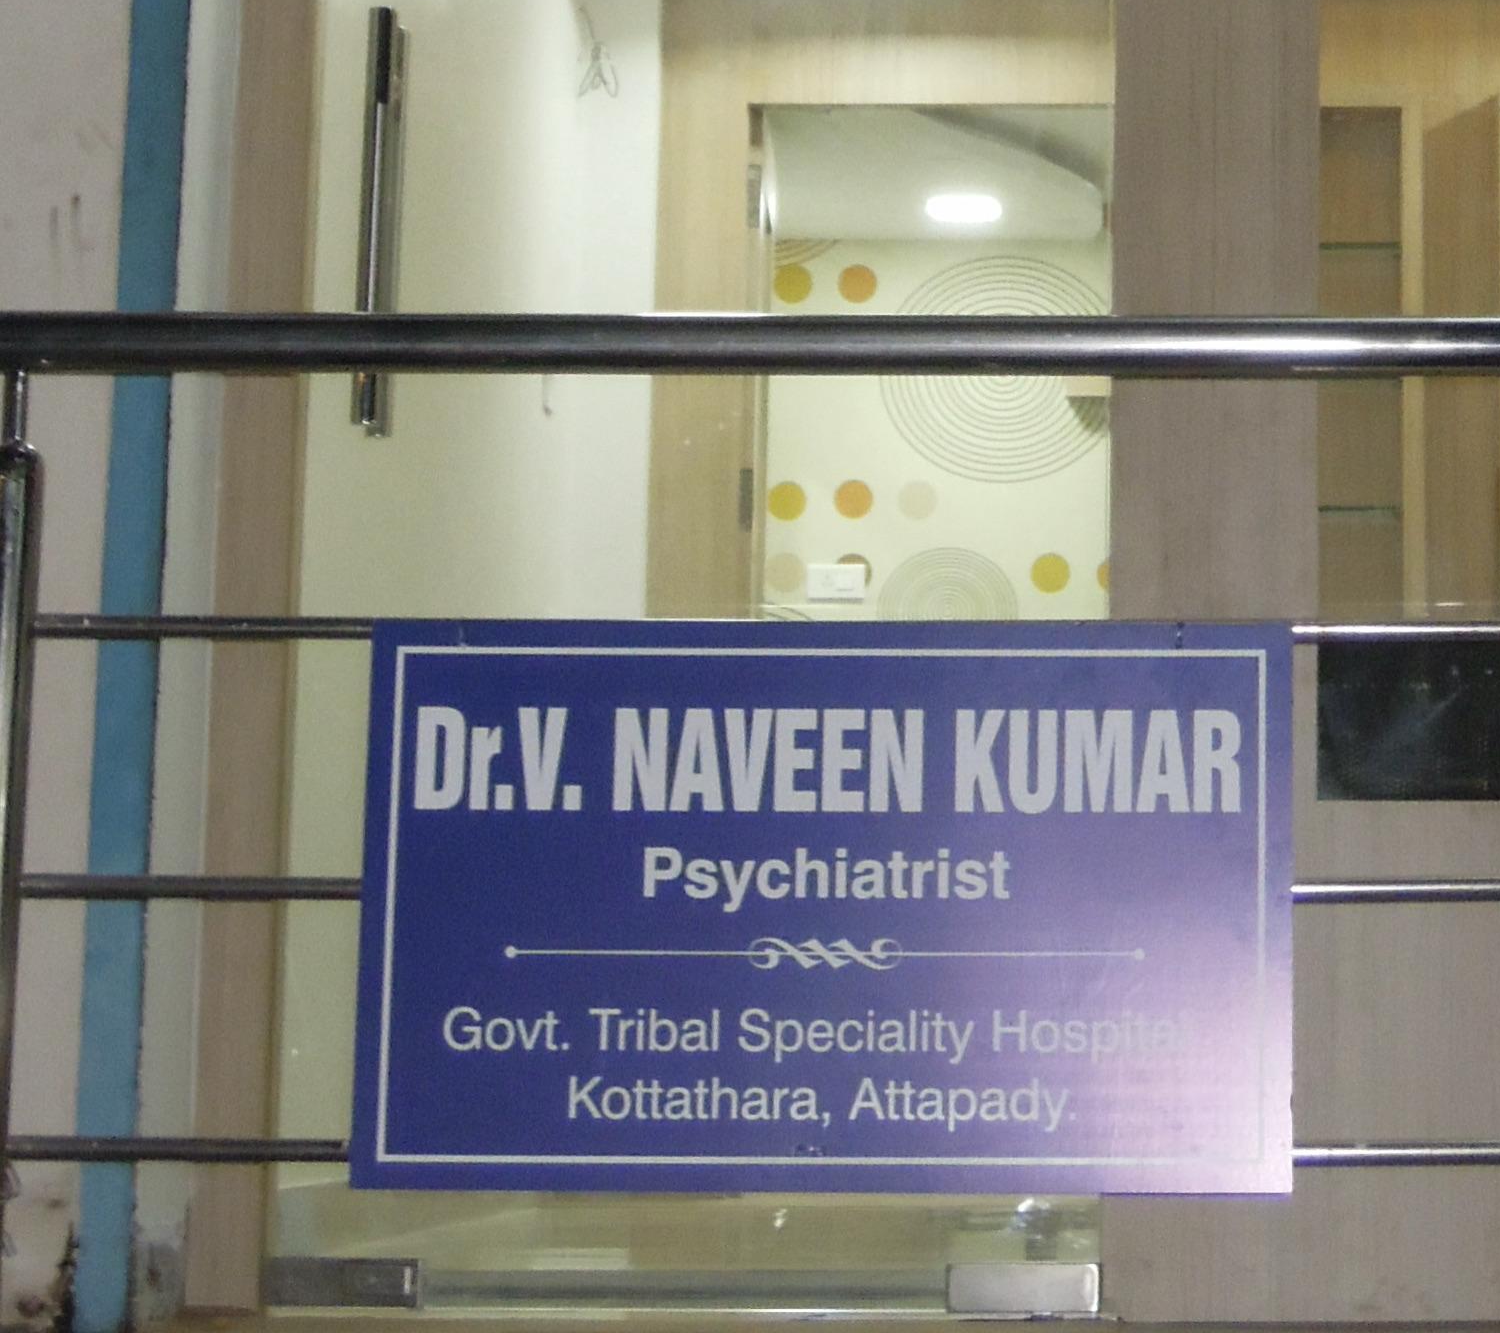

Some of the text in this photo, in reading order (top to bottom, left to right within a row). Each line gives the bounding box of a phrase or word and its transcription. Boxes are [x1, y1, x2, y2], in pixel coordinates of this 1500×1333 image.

[414, 706, 1242, 814] Dr.V. NAVEEN KUMAR
[642, 846, 1012, 912] Psychiatrist
[443, 1007, 570, 1052] Govt.
[590, 1007, 721, 1052] Tribal
[739, 1007, 972, 1064] Speciality
[567, 1076, 1077, 1133] Kottathara, Attapady.
